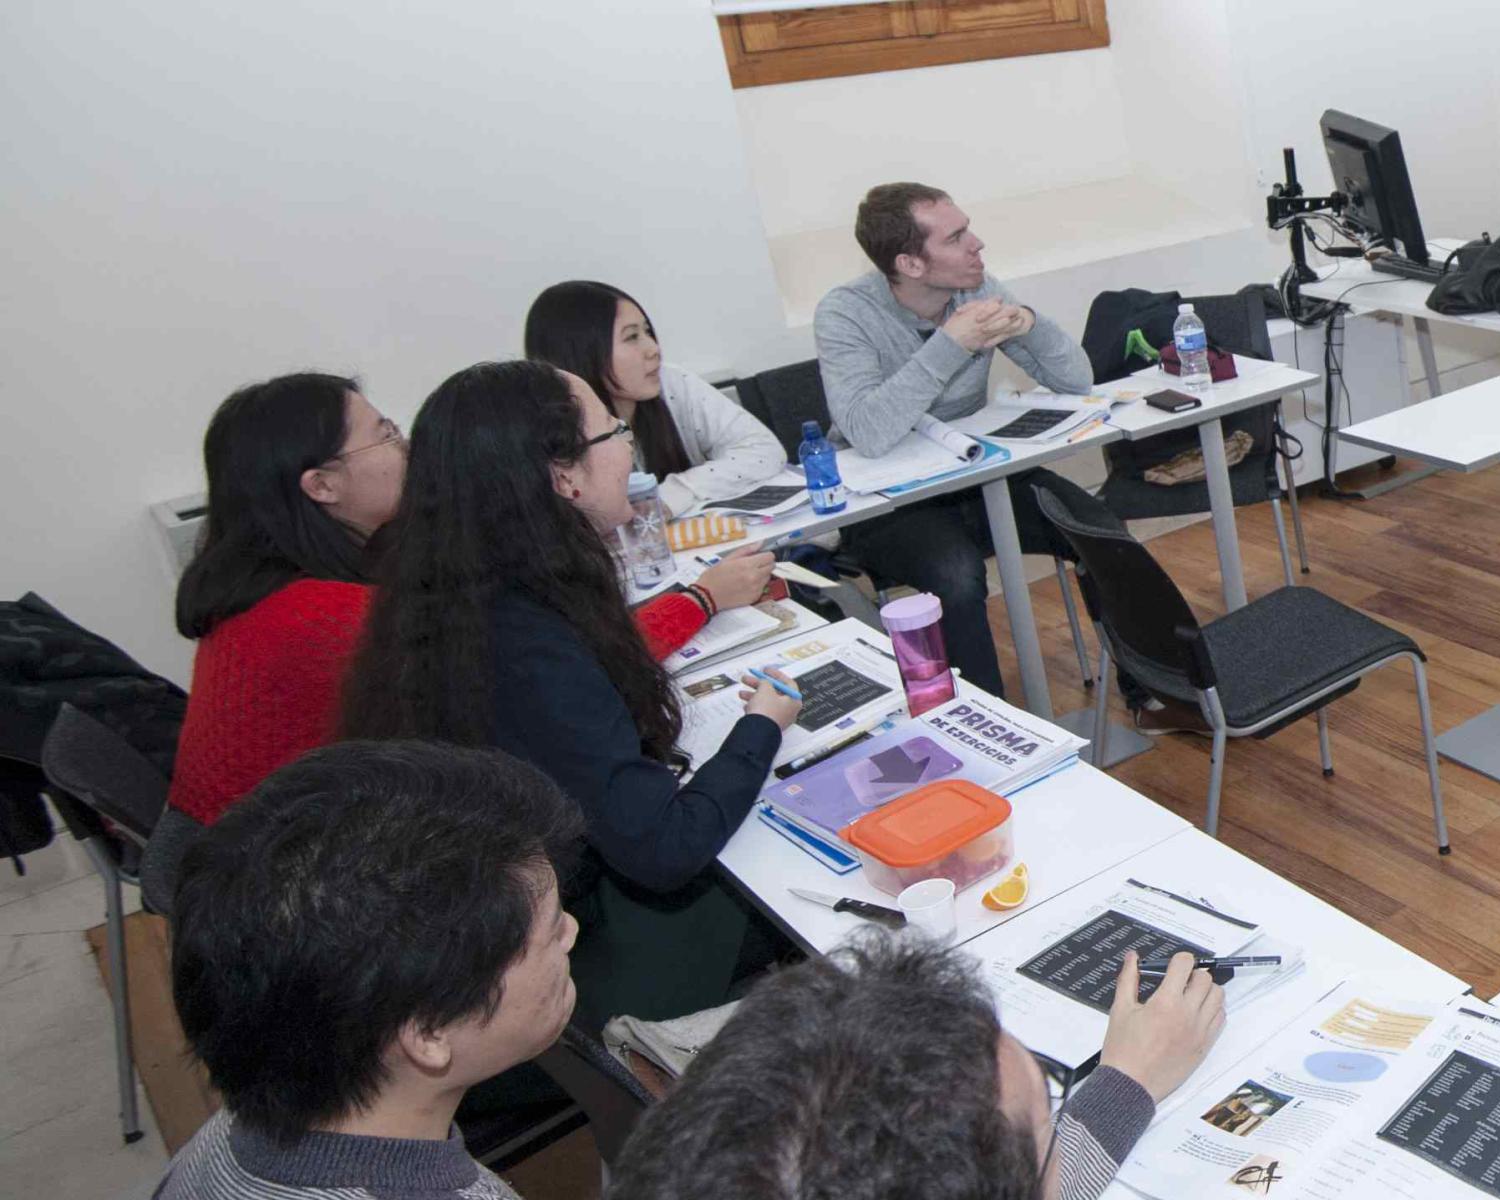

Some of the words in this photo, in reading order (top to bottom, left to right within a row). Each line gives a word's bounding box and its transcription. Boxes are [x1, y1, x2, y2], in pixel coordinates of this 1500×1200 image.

[929, 717, 949, 730] DE
[946, 727, 1018, 767] EJERCICIOS
[946, 704, 1039, 756] PRISMA
